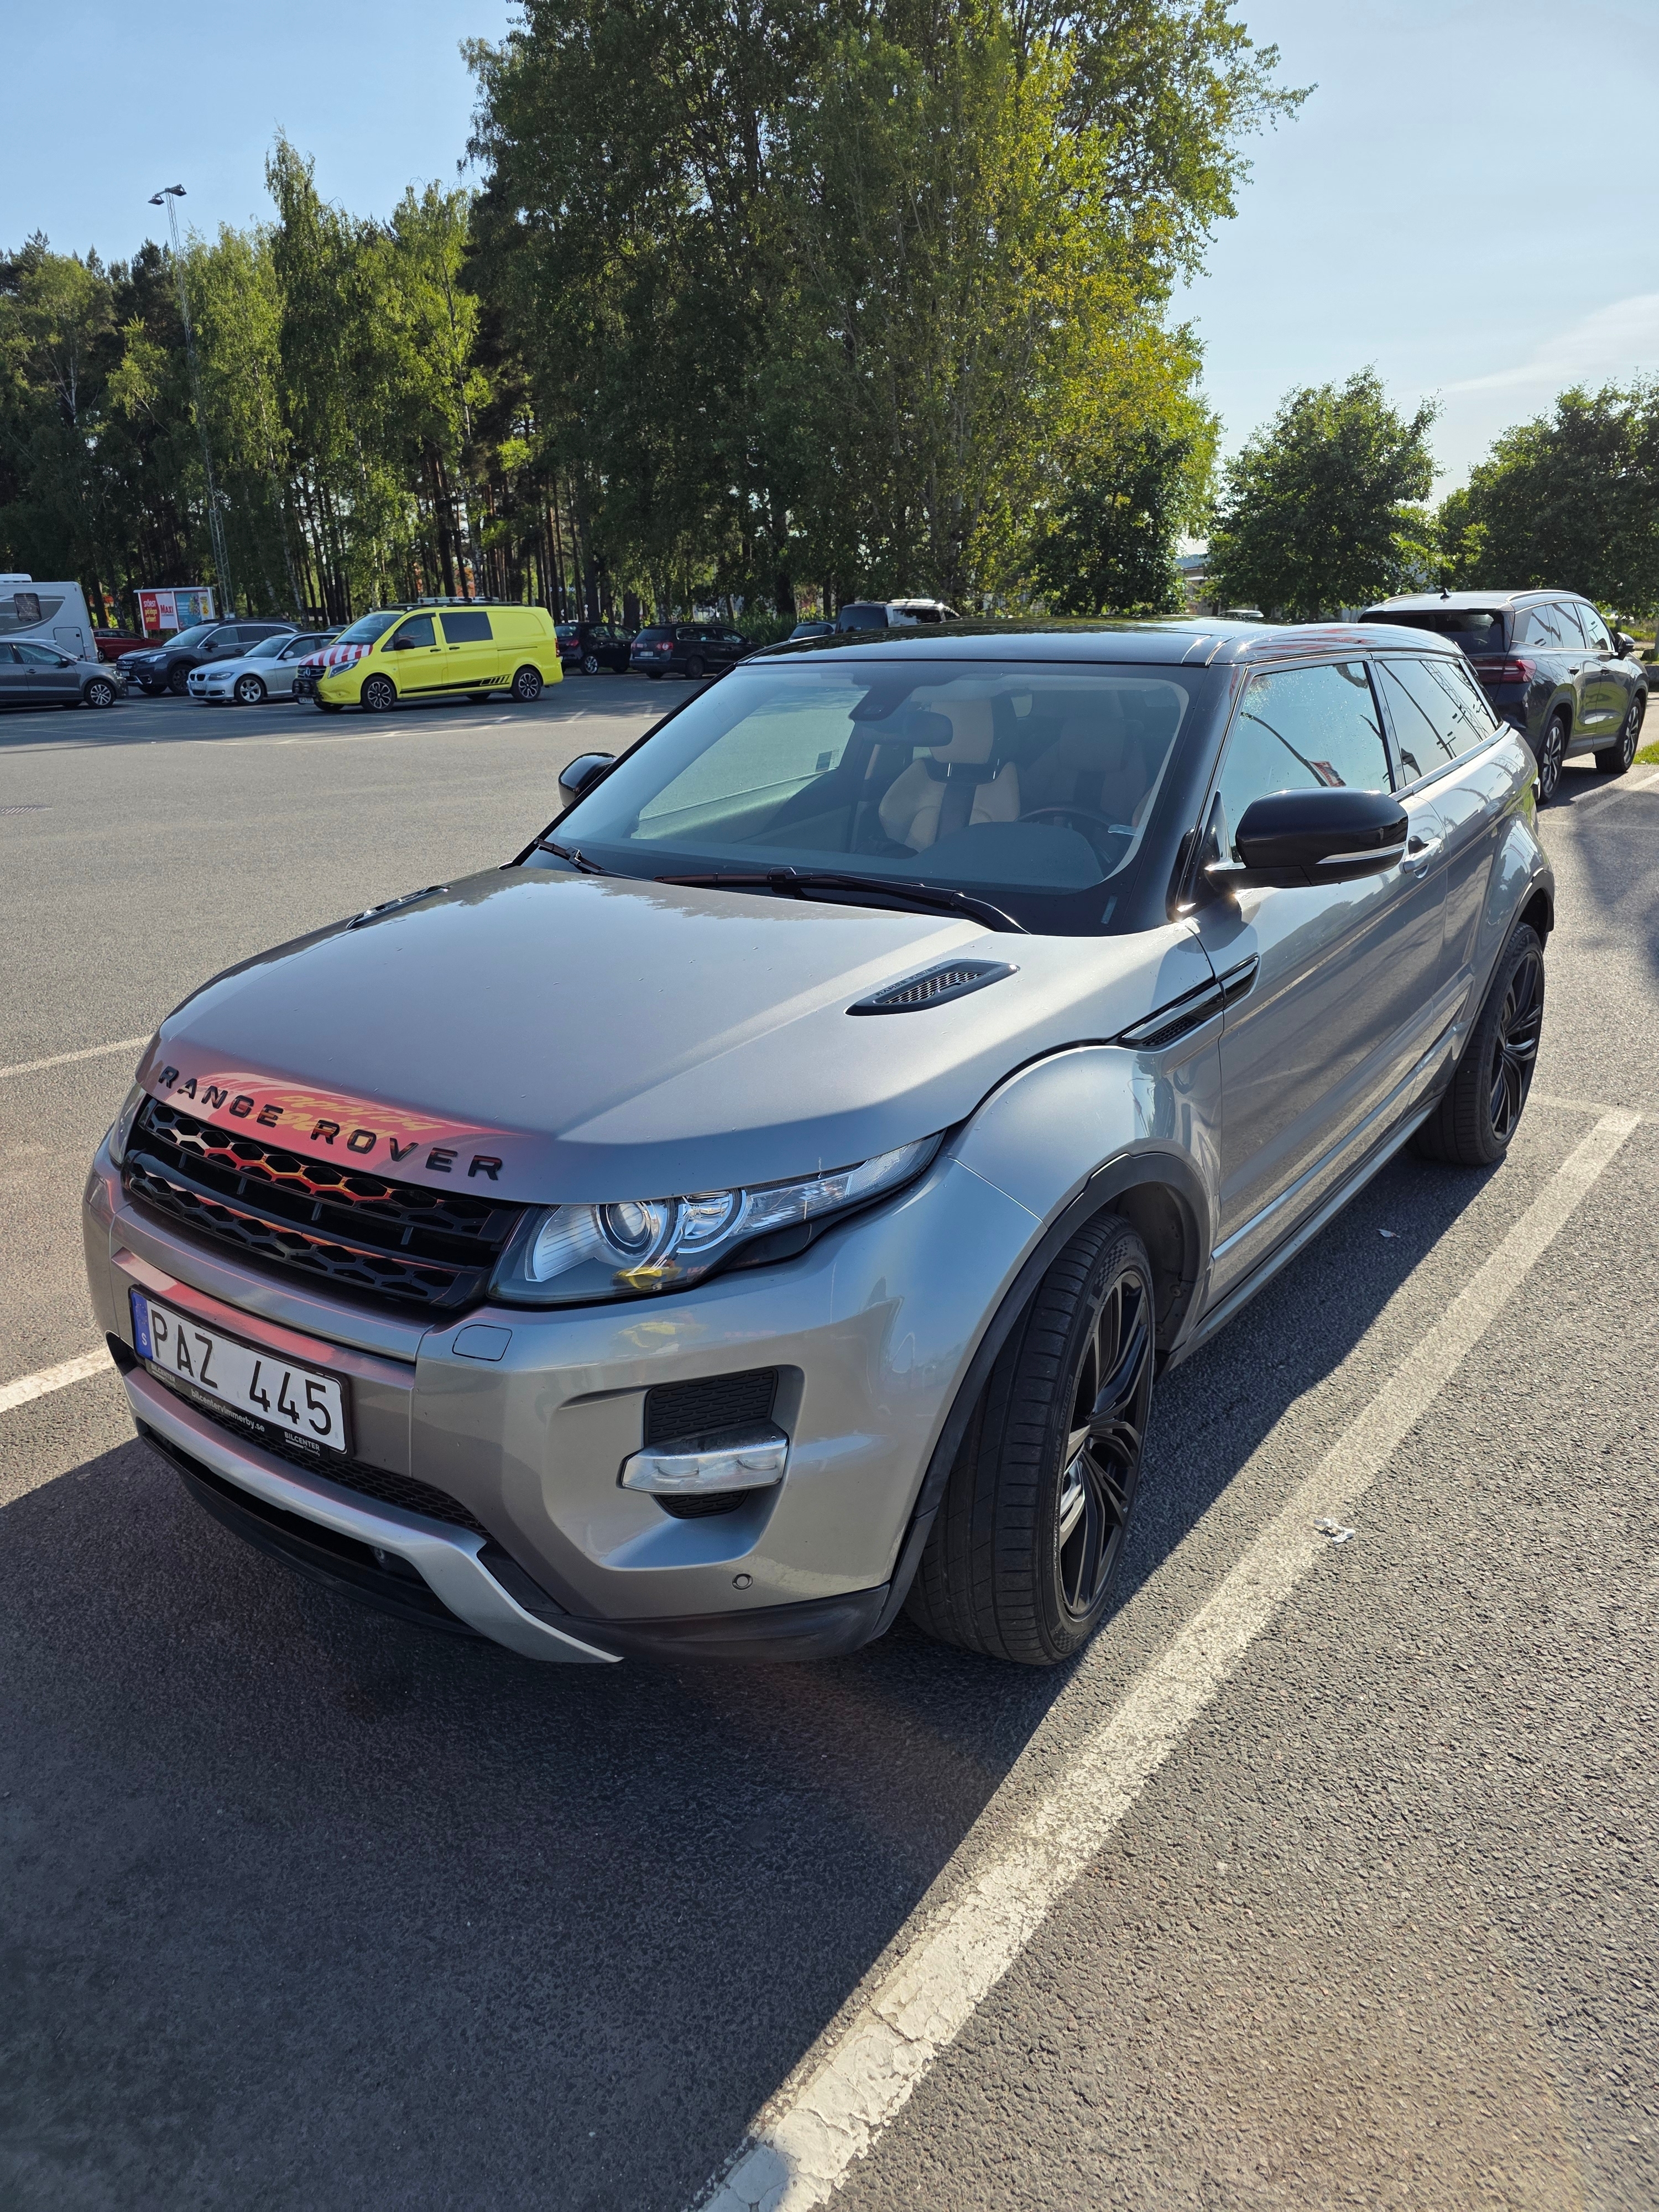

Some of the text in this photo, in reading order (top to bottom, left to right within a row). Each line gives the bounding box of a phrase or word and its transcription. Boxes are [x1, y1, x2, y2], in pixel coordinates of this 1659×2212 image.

[160, 604, 174, 613] MAXI
[158, 1065, 503, 1181] RANGE ROVER
[142, 1332, 148, 1346] S
[151, 1308, 331, 1436] PAZ 445
[191, 1389, 265, 1432] bilcentervimmerby.se
[284, 1431, 320, 1451] BILCENTER
[1052, 1434, 1061, 1481] 103W
